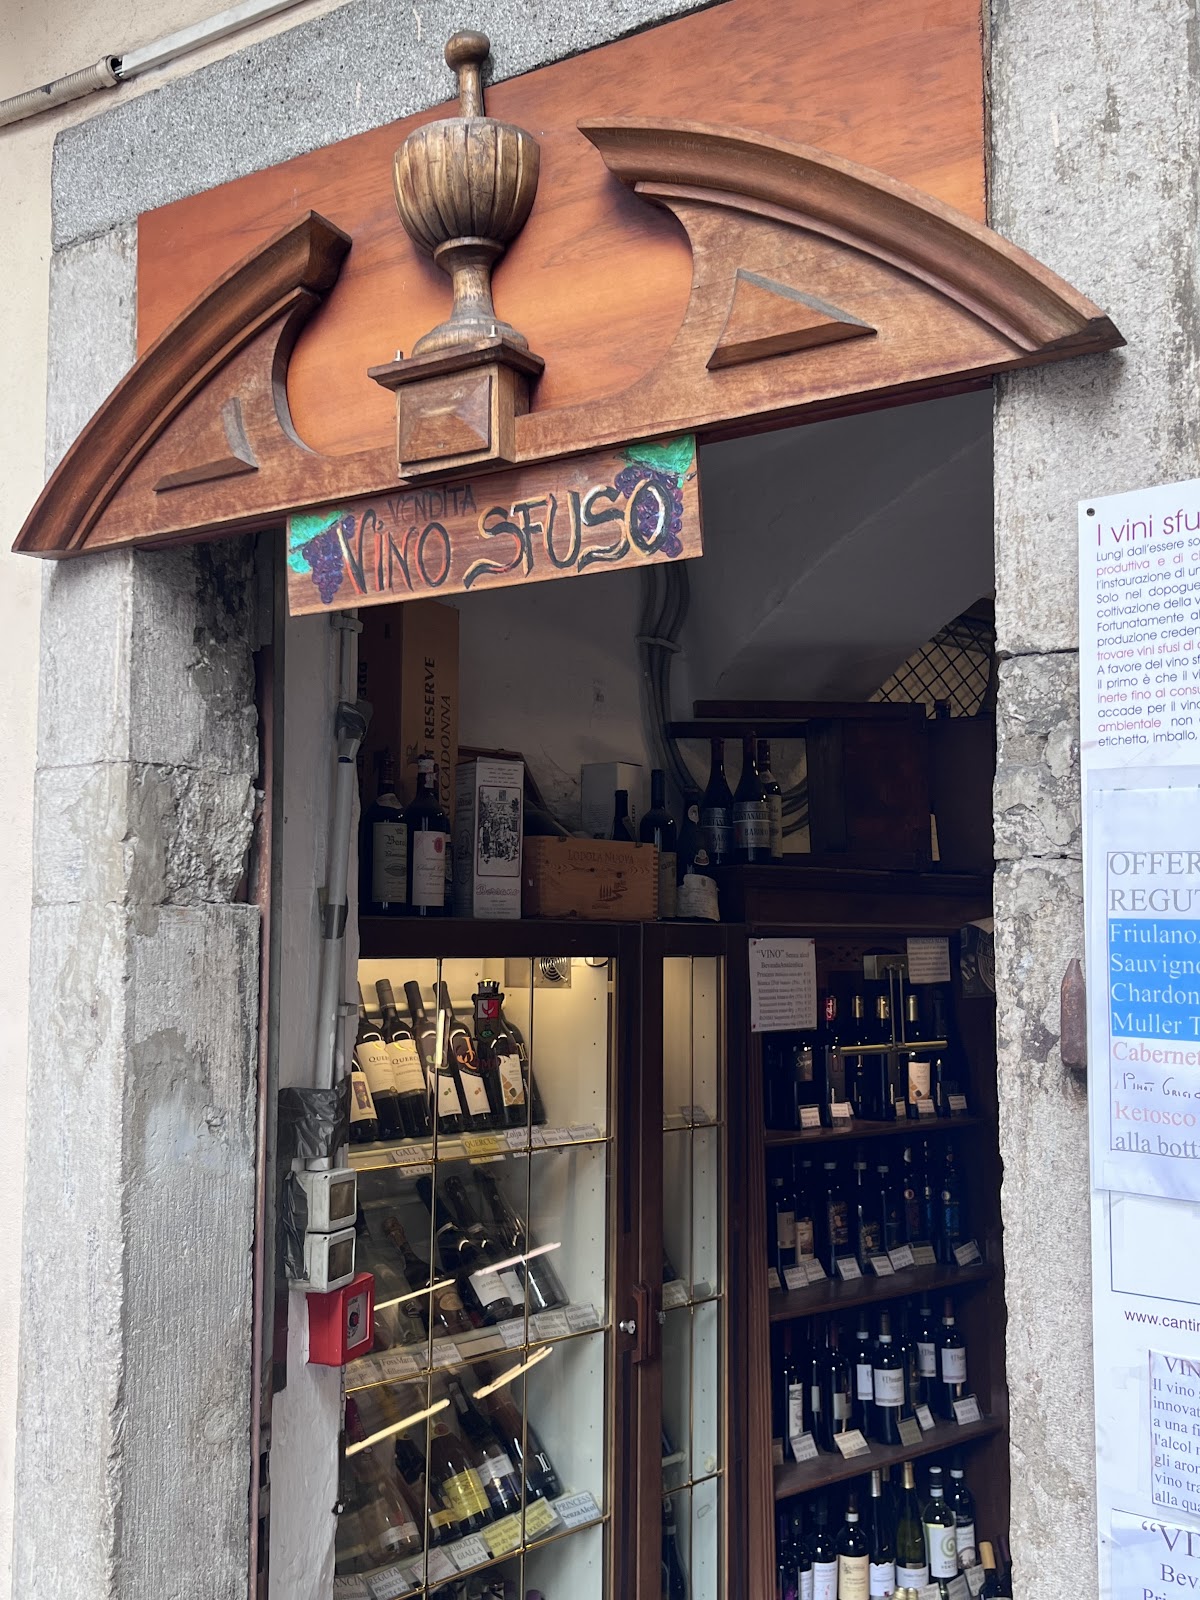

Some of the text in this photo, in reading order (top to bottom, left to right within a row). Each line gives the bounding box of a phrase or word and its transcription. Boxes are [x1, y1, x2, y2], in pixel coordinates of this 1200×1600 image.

[463, 478, 672, 590] SFUSO
[1110, 514, 1153, 543] vini
[1096, 548, 1124, 562] Lungi
[1126, 540, 1185, 557] dall'essere
[1096, 560, 1150, 578] produttiva
[1157, 558, 1165, 566] e
[1173, 553, 1184, 564] di
[1096, 571, 1171, 590] l'instaurazione
[1174, 567, 1185, 579] di
[1096, 593, 1119, 604] Solo
[1125, 588, 1142, 600] nel
[1096, 602, 1161, 618] coltivazione
[1163, 597, 1192, 609] della
[1097, 613, 1184, 632] Fortunatamente
[1097, 631, 1158, 648] produzione
[1097, 639, 1194, 661] trovare vini sfusi di
[1096, 665, 1105, 675] A
[1107, 662, 1142, 674] favore
[1145, 658, 1163, 670] del
[1165, 657, 1190, 668] vino
[1106, 677, 1139, 690] primo
[1142, 673, 1151, 684] è
[1155, 672, 1178, 684] che
[424, 656, 435, 740] RESERVE
[1097, 692, 1128, 704] inerte
[1131, 689, 1152, 700] fino
[1155, 687, 1166, 698] al
[1097, 705, 1143, 718] accade
[1147, 703, 1166, 716] per
[1098, 716, 1193, 732] ambientale non
[1098, 730, 1198, 747] etichetta, imballo,
[1112, 1012, 1183, 1034] Muller
[465, 1138, 497, 1149] QUERCUS
[1115, 1131, 1200, 1159] alla bott
[1153, 1378, 1195, 1398] Il vino
[1153, 1417, 1161, 1428] a
[1165, 1420, 1188, 1434] una
[1154, 1433, 1192, 1454] l'alcol
[1154, 1454, 1170, 1467] gli
[1155, 1472, 1183, 1488] vino
[559, 1495, 592, 1512] PRINCESS
[1155, 1491, 1178, 1506] alla
[456, 1546, 483, 1561] GIALLA
